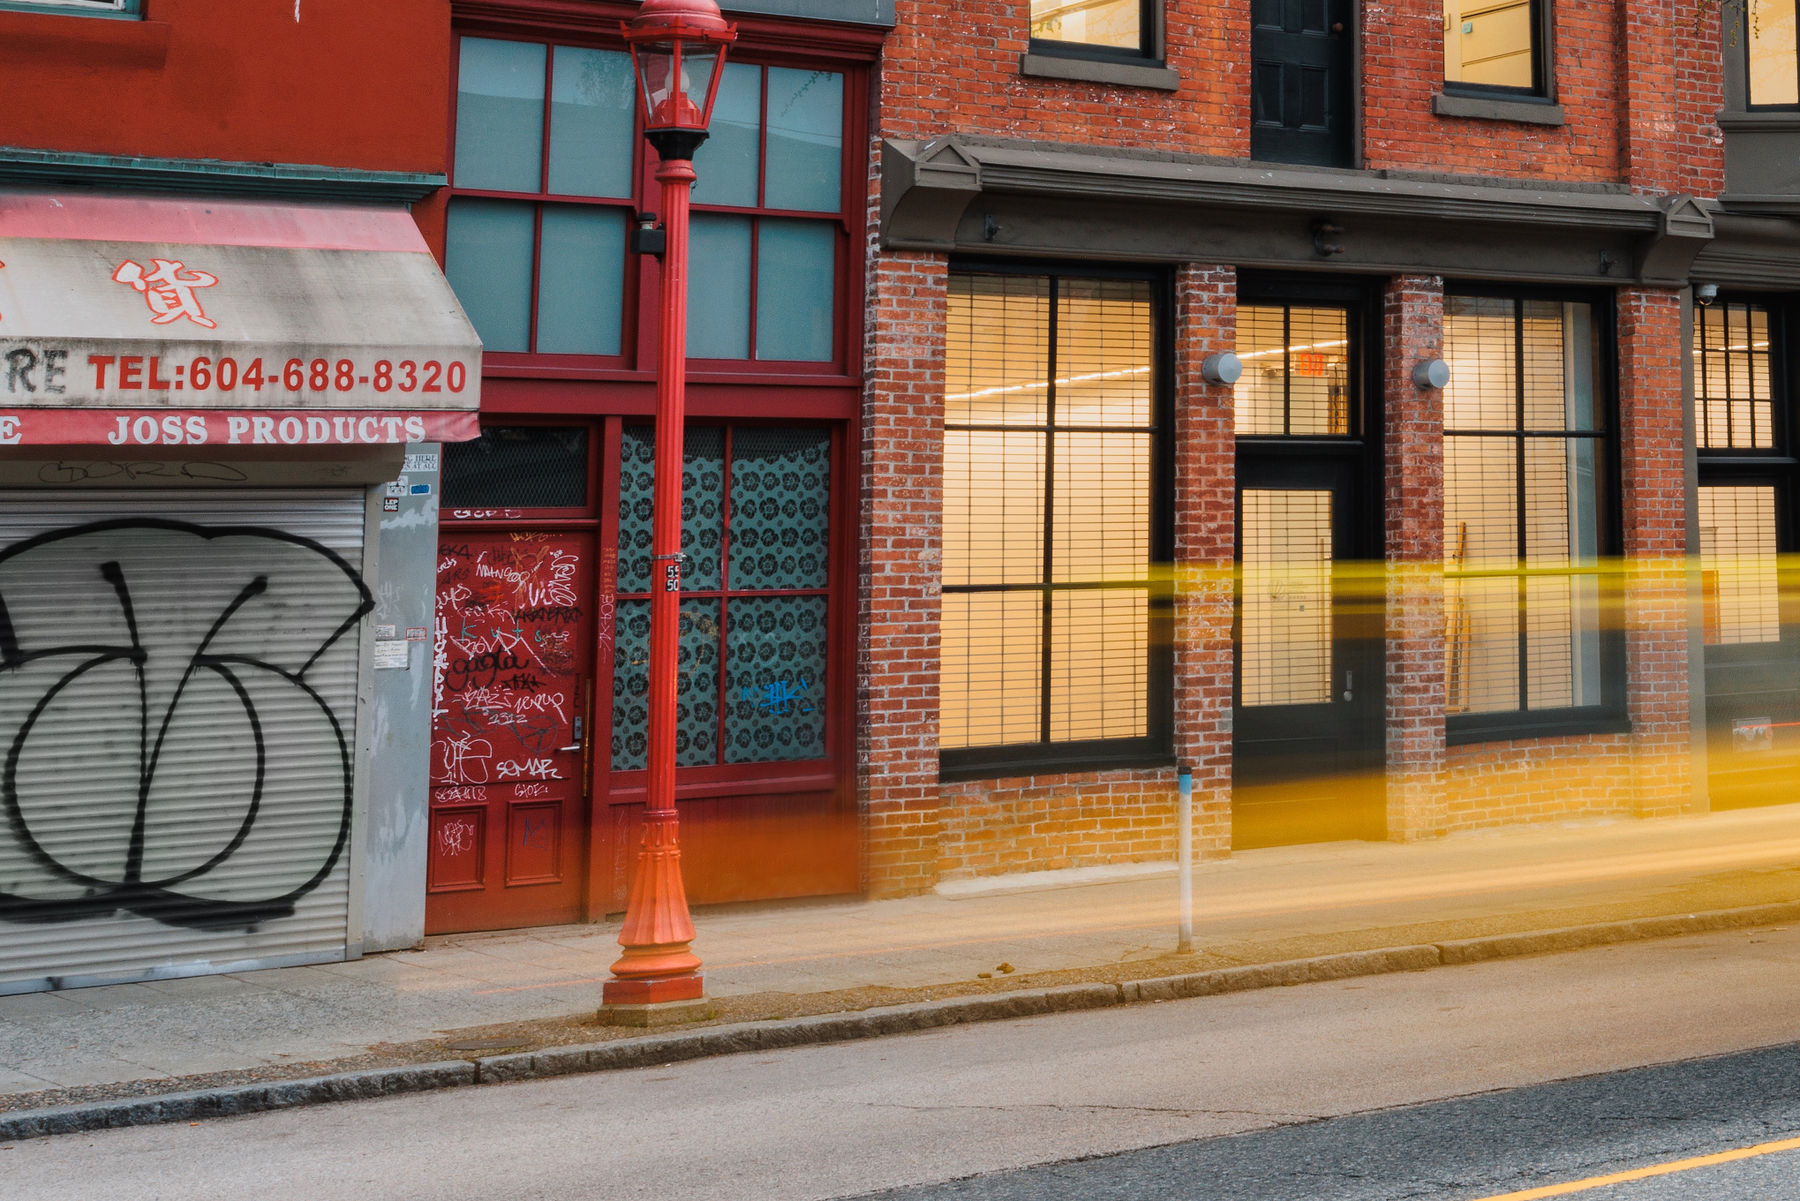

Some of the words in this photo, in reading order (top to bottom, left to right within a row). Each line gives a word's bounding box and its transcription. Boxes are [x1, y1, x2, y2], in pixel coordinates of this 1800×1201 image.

[112, 258, 219, 329] 貨
[5, 348, 68, 393] RE
[108, 415, 208, 445] JOSS
[226, 414, 426, 444] PRODUCTS
